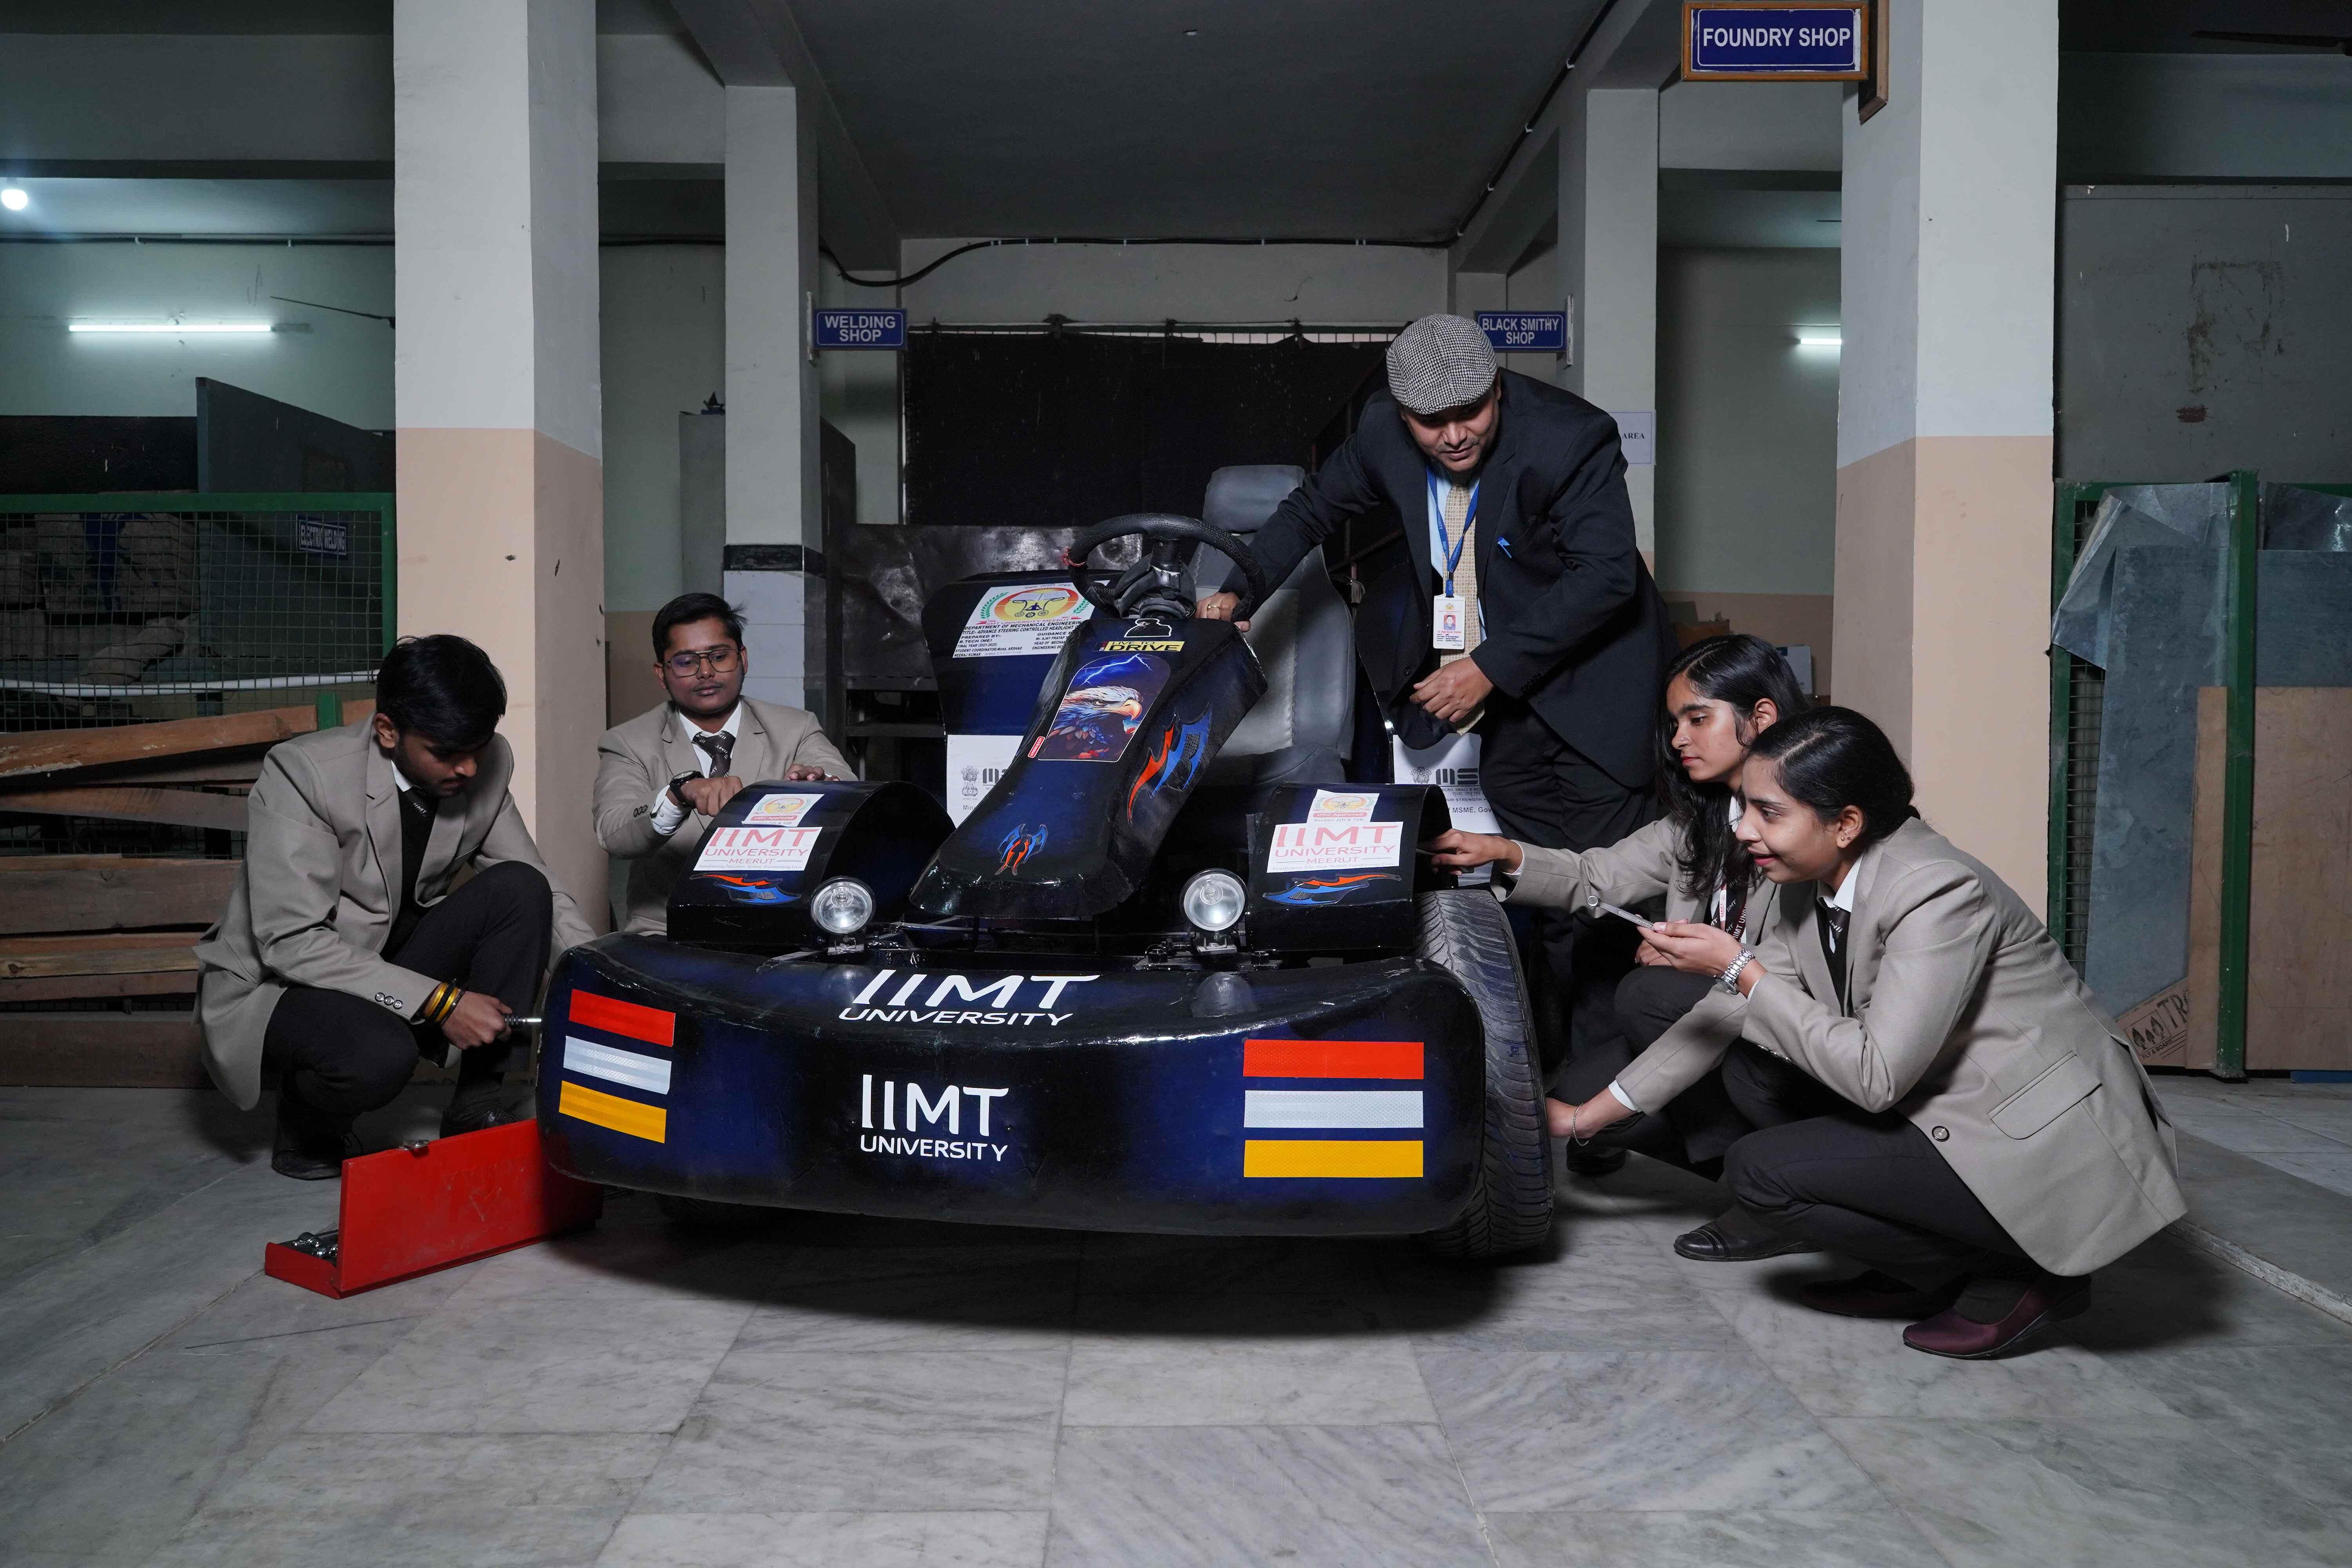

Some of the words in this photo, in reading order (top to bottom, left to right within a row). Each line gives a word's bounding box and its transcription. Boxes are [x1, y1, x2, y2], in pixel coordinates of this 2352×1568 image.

[1703, 28, 1794, 47] FOUNDRY
[1798, 28, 1851, 47] SHOP
[824, 316, 896, 328] WELDING
[1482, 318, 1517, 331] BLACK
[1521, 318, 1559, 331] SMITHY
[839, 329, 882, 342] SHOP
[1506, 332, 1535, 344] SHOP
[710, 828, 819, 847] IIMT
[1276, 825, 1399, 847] IIMT
[1275, 845, 1396, 857] UNIVERSITY
[1727, 899, 1736, 913] IIMT
[852, 969, 1100, 1009] IIMT
[838, 1007, 1074, 1026] UNIVERSITY
[2156, 1039, 2173, 1051] BOARD
[862, 1074, 1009, 1137] IIMT
[860, 1134, 1008, 1162] UNIVERSITY
